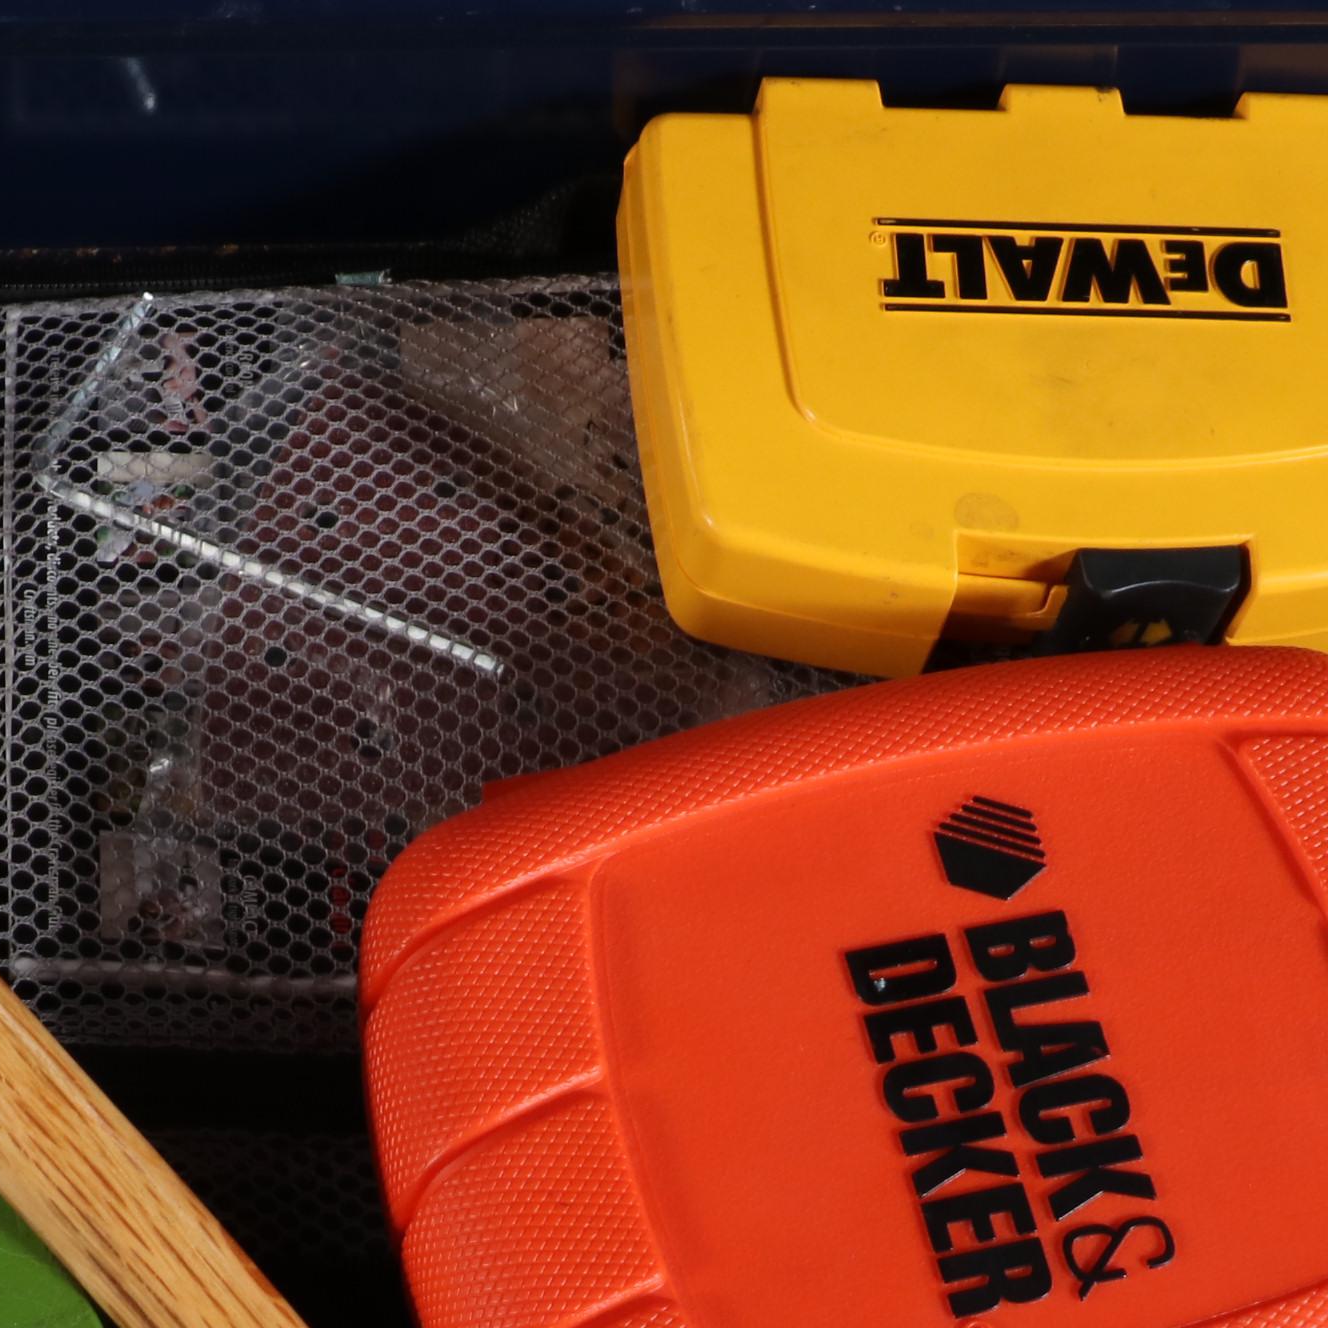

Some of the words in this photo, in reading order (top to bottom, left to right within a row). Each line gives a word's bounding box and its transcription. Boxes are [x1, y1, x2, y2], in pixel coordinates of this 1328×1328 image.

[845, 933, 1052, 1318] DECKER
[963, 910, 1156, 1222] BLACK
[1061, 1216, 1175, 1301] &
